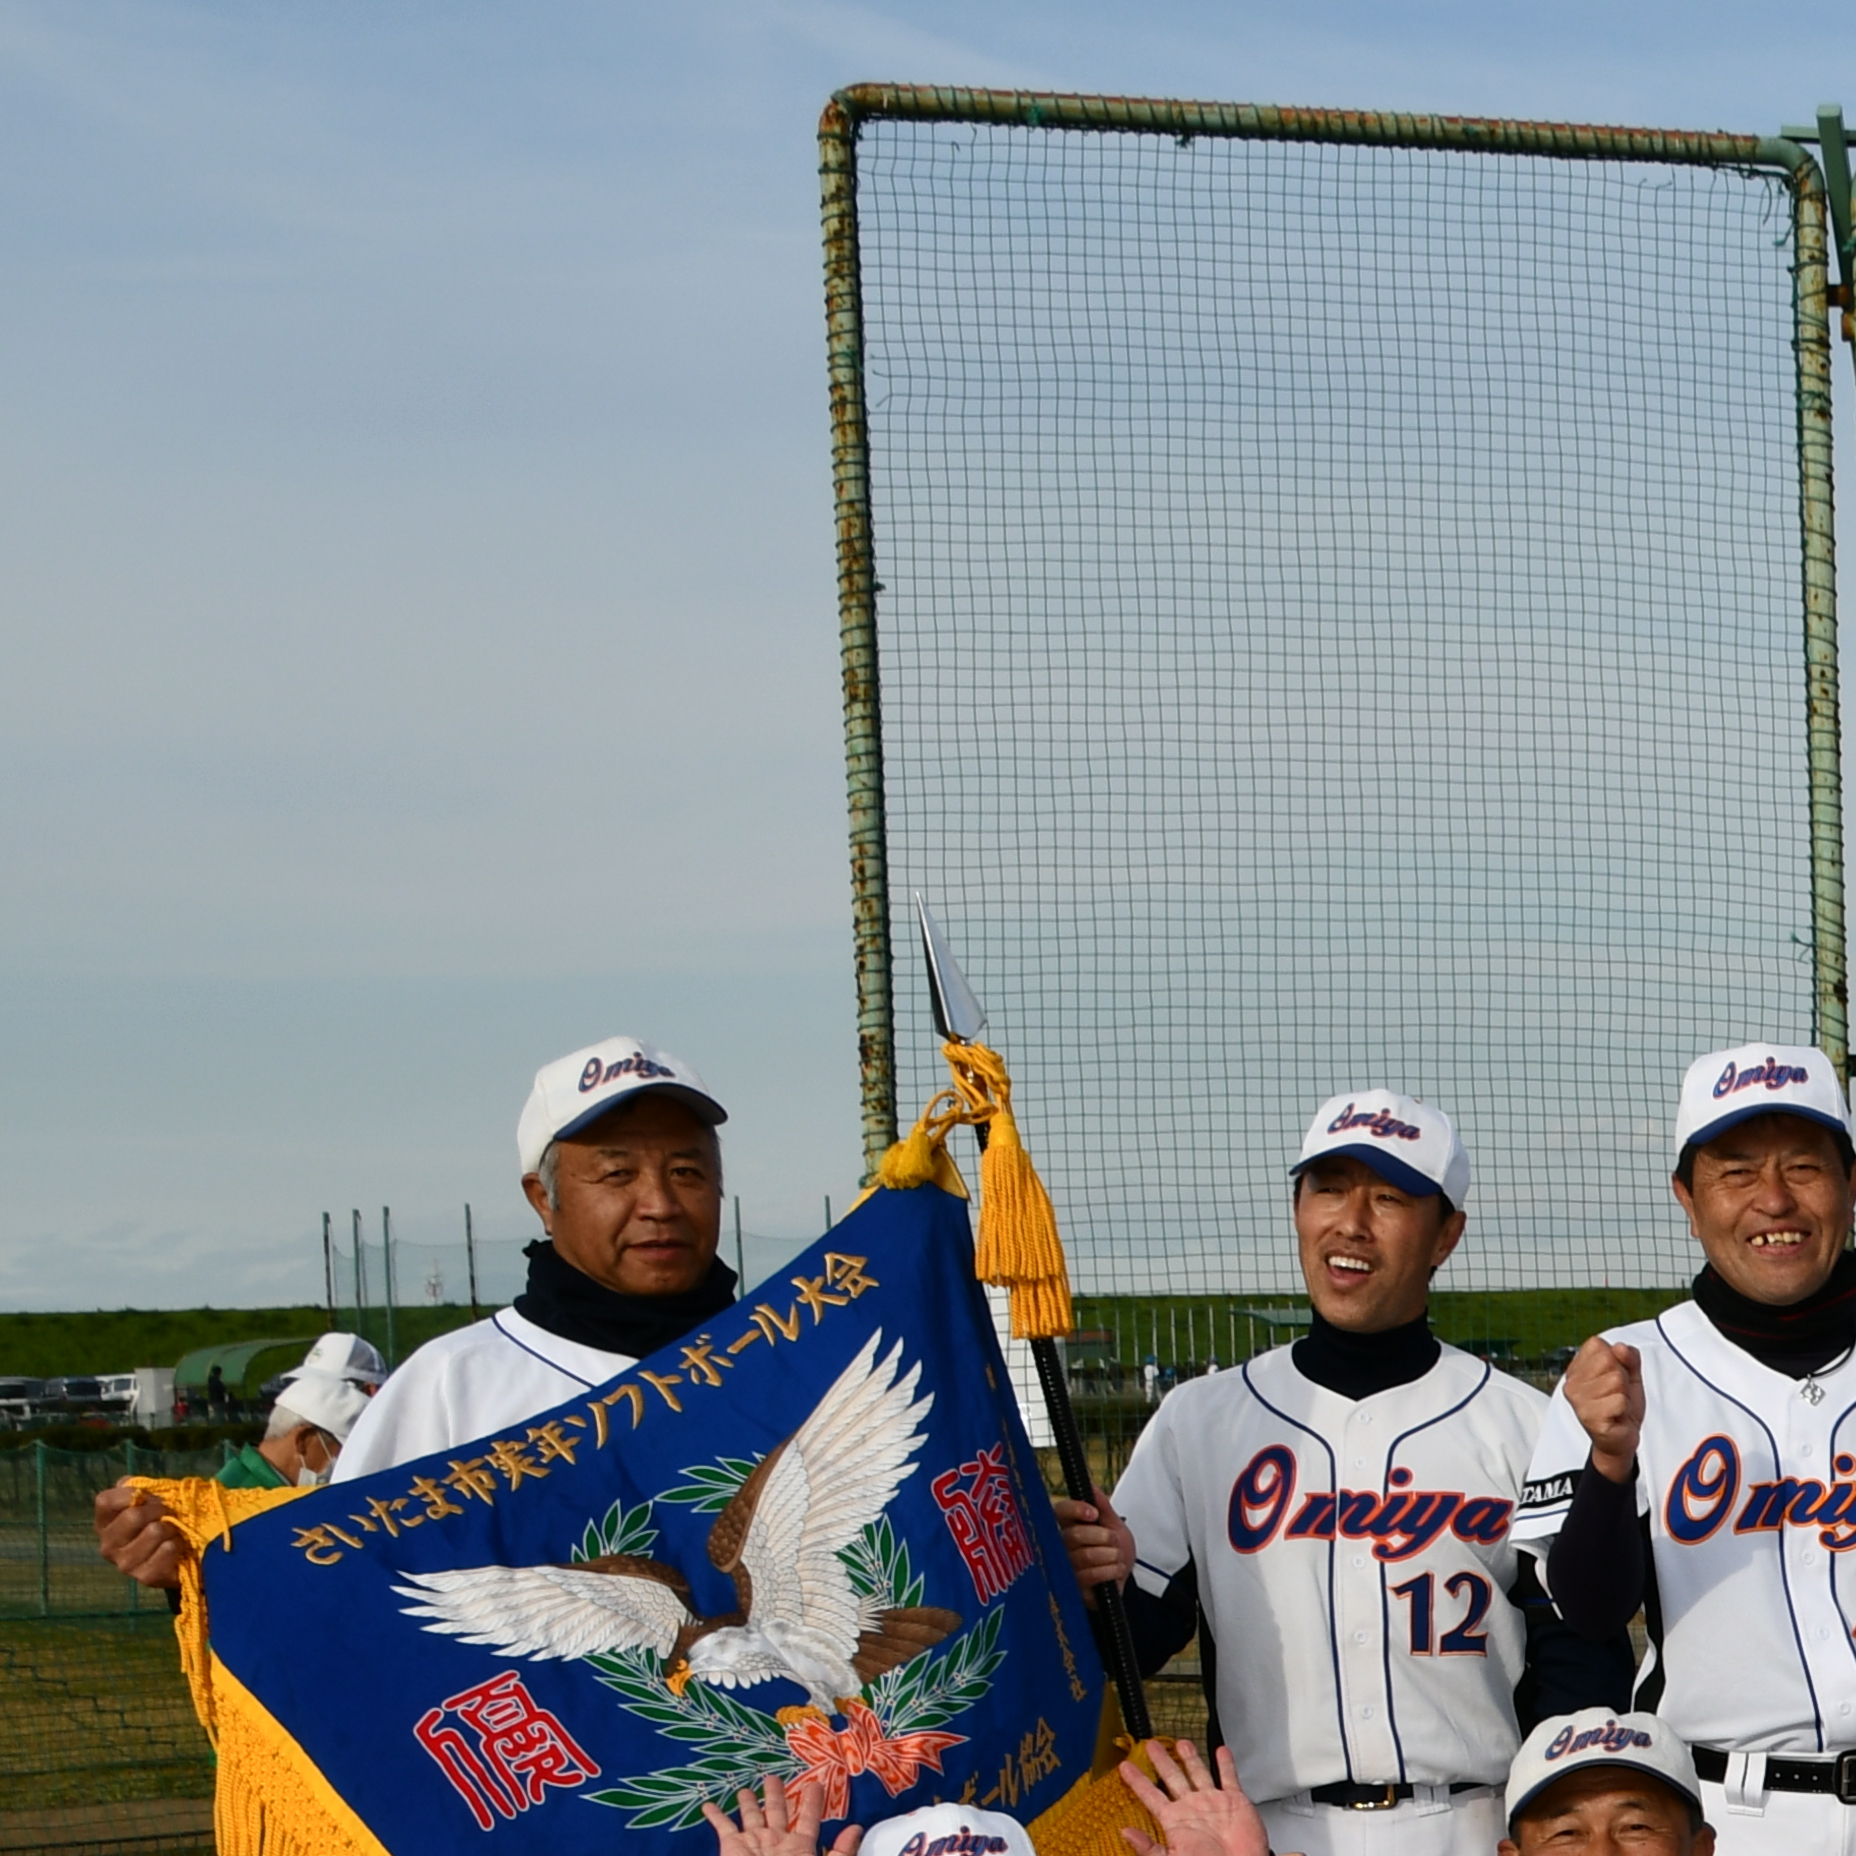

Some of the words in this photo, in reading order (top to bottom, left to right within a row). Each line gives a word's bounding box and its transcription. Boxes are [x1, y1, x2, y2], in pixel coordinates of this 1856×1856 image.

[578, 1052, 676, 1093] Omiya
[1711, 1059, 1809, 1099] Omiya
[1327, 1104, 1421, 1142] Omiya
[291, 1251, 879, 1566] さいたま市実年ソフトボール大会
[1227, 1444, 1514, 1563] Omiya
[1388, 1571, 1493, 1658] 12
[1543, 1720, 1652, 1762] Omiya
